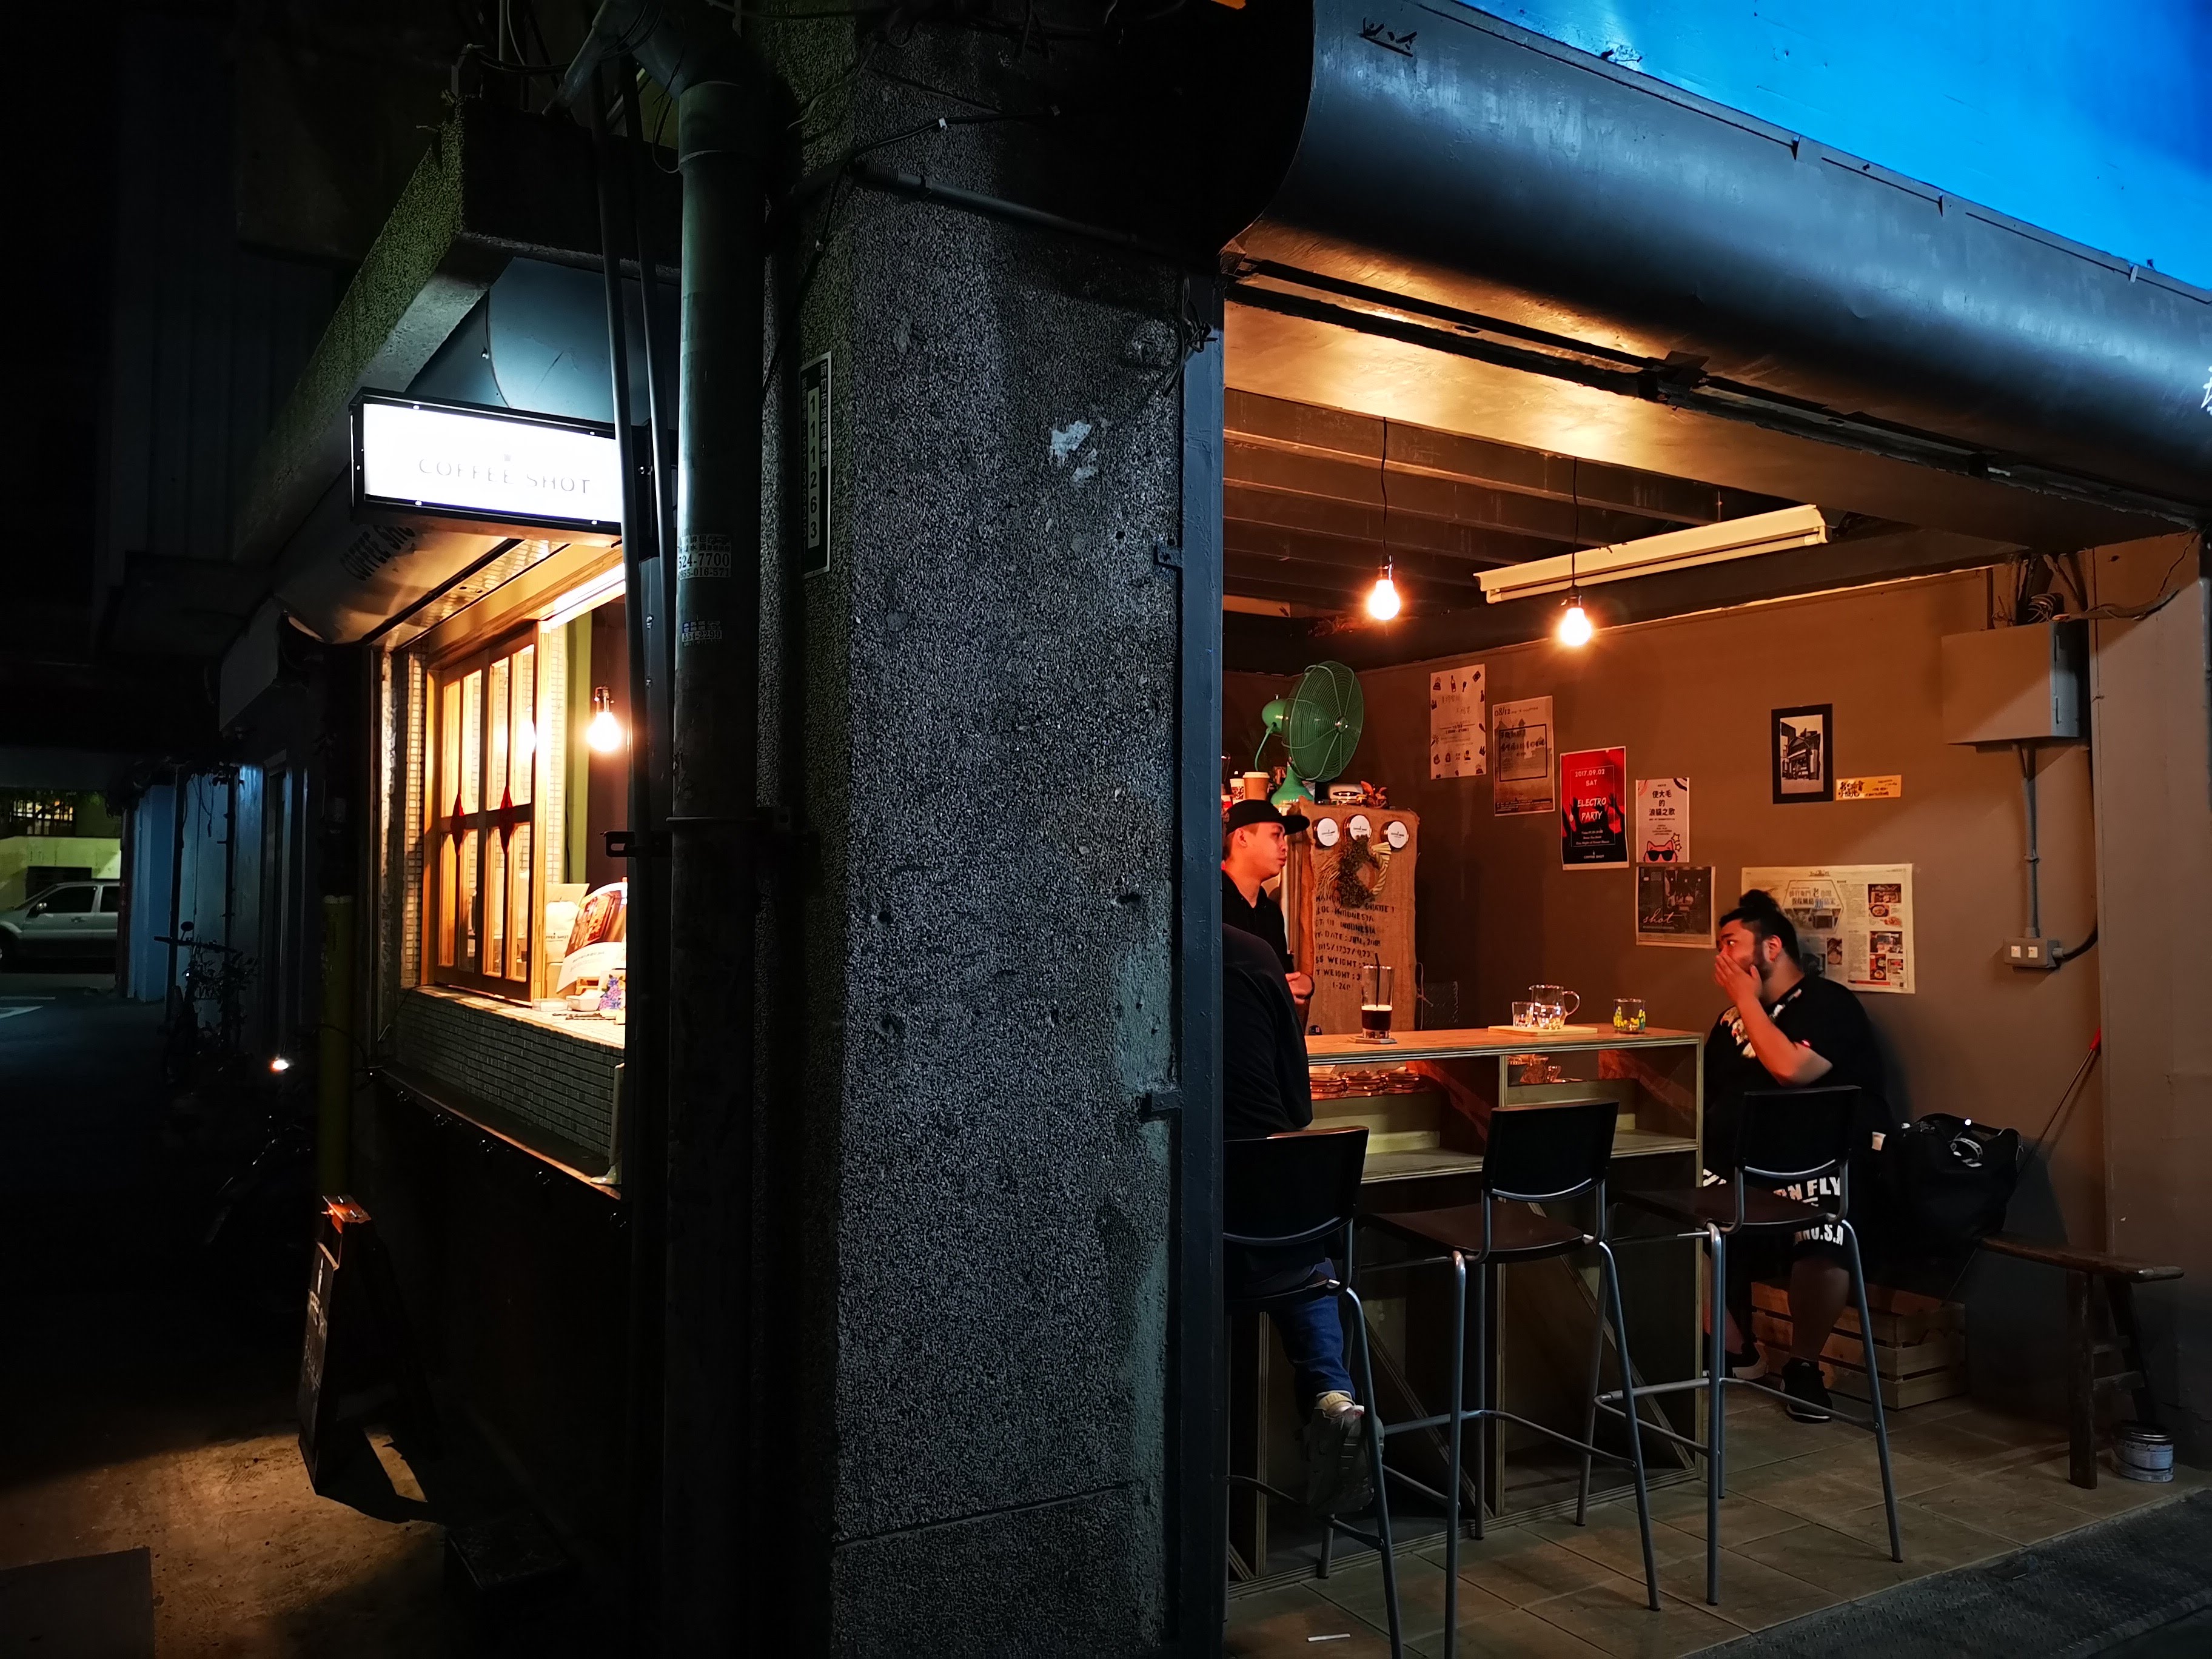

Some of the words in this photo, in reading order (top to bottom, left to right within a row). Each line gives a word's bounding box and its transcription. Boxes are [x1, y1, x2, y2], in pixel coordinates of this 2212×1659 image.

[809, 394, 818, 540] 111263
[418, 458, 514, 484] COFFEE
[526, 474, 591, 494] SHOT
[1575, 768, 1605, 777] 2017.09.02
[1577, 797, 1607, 808] ELECTRO
[1581, 811, 1603, 821] PARTY
[1643, 908, 1683, 923] shot
[1806, 1176, 1840, 1197] FLY
